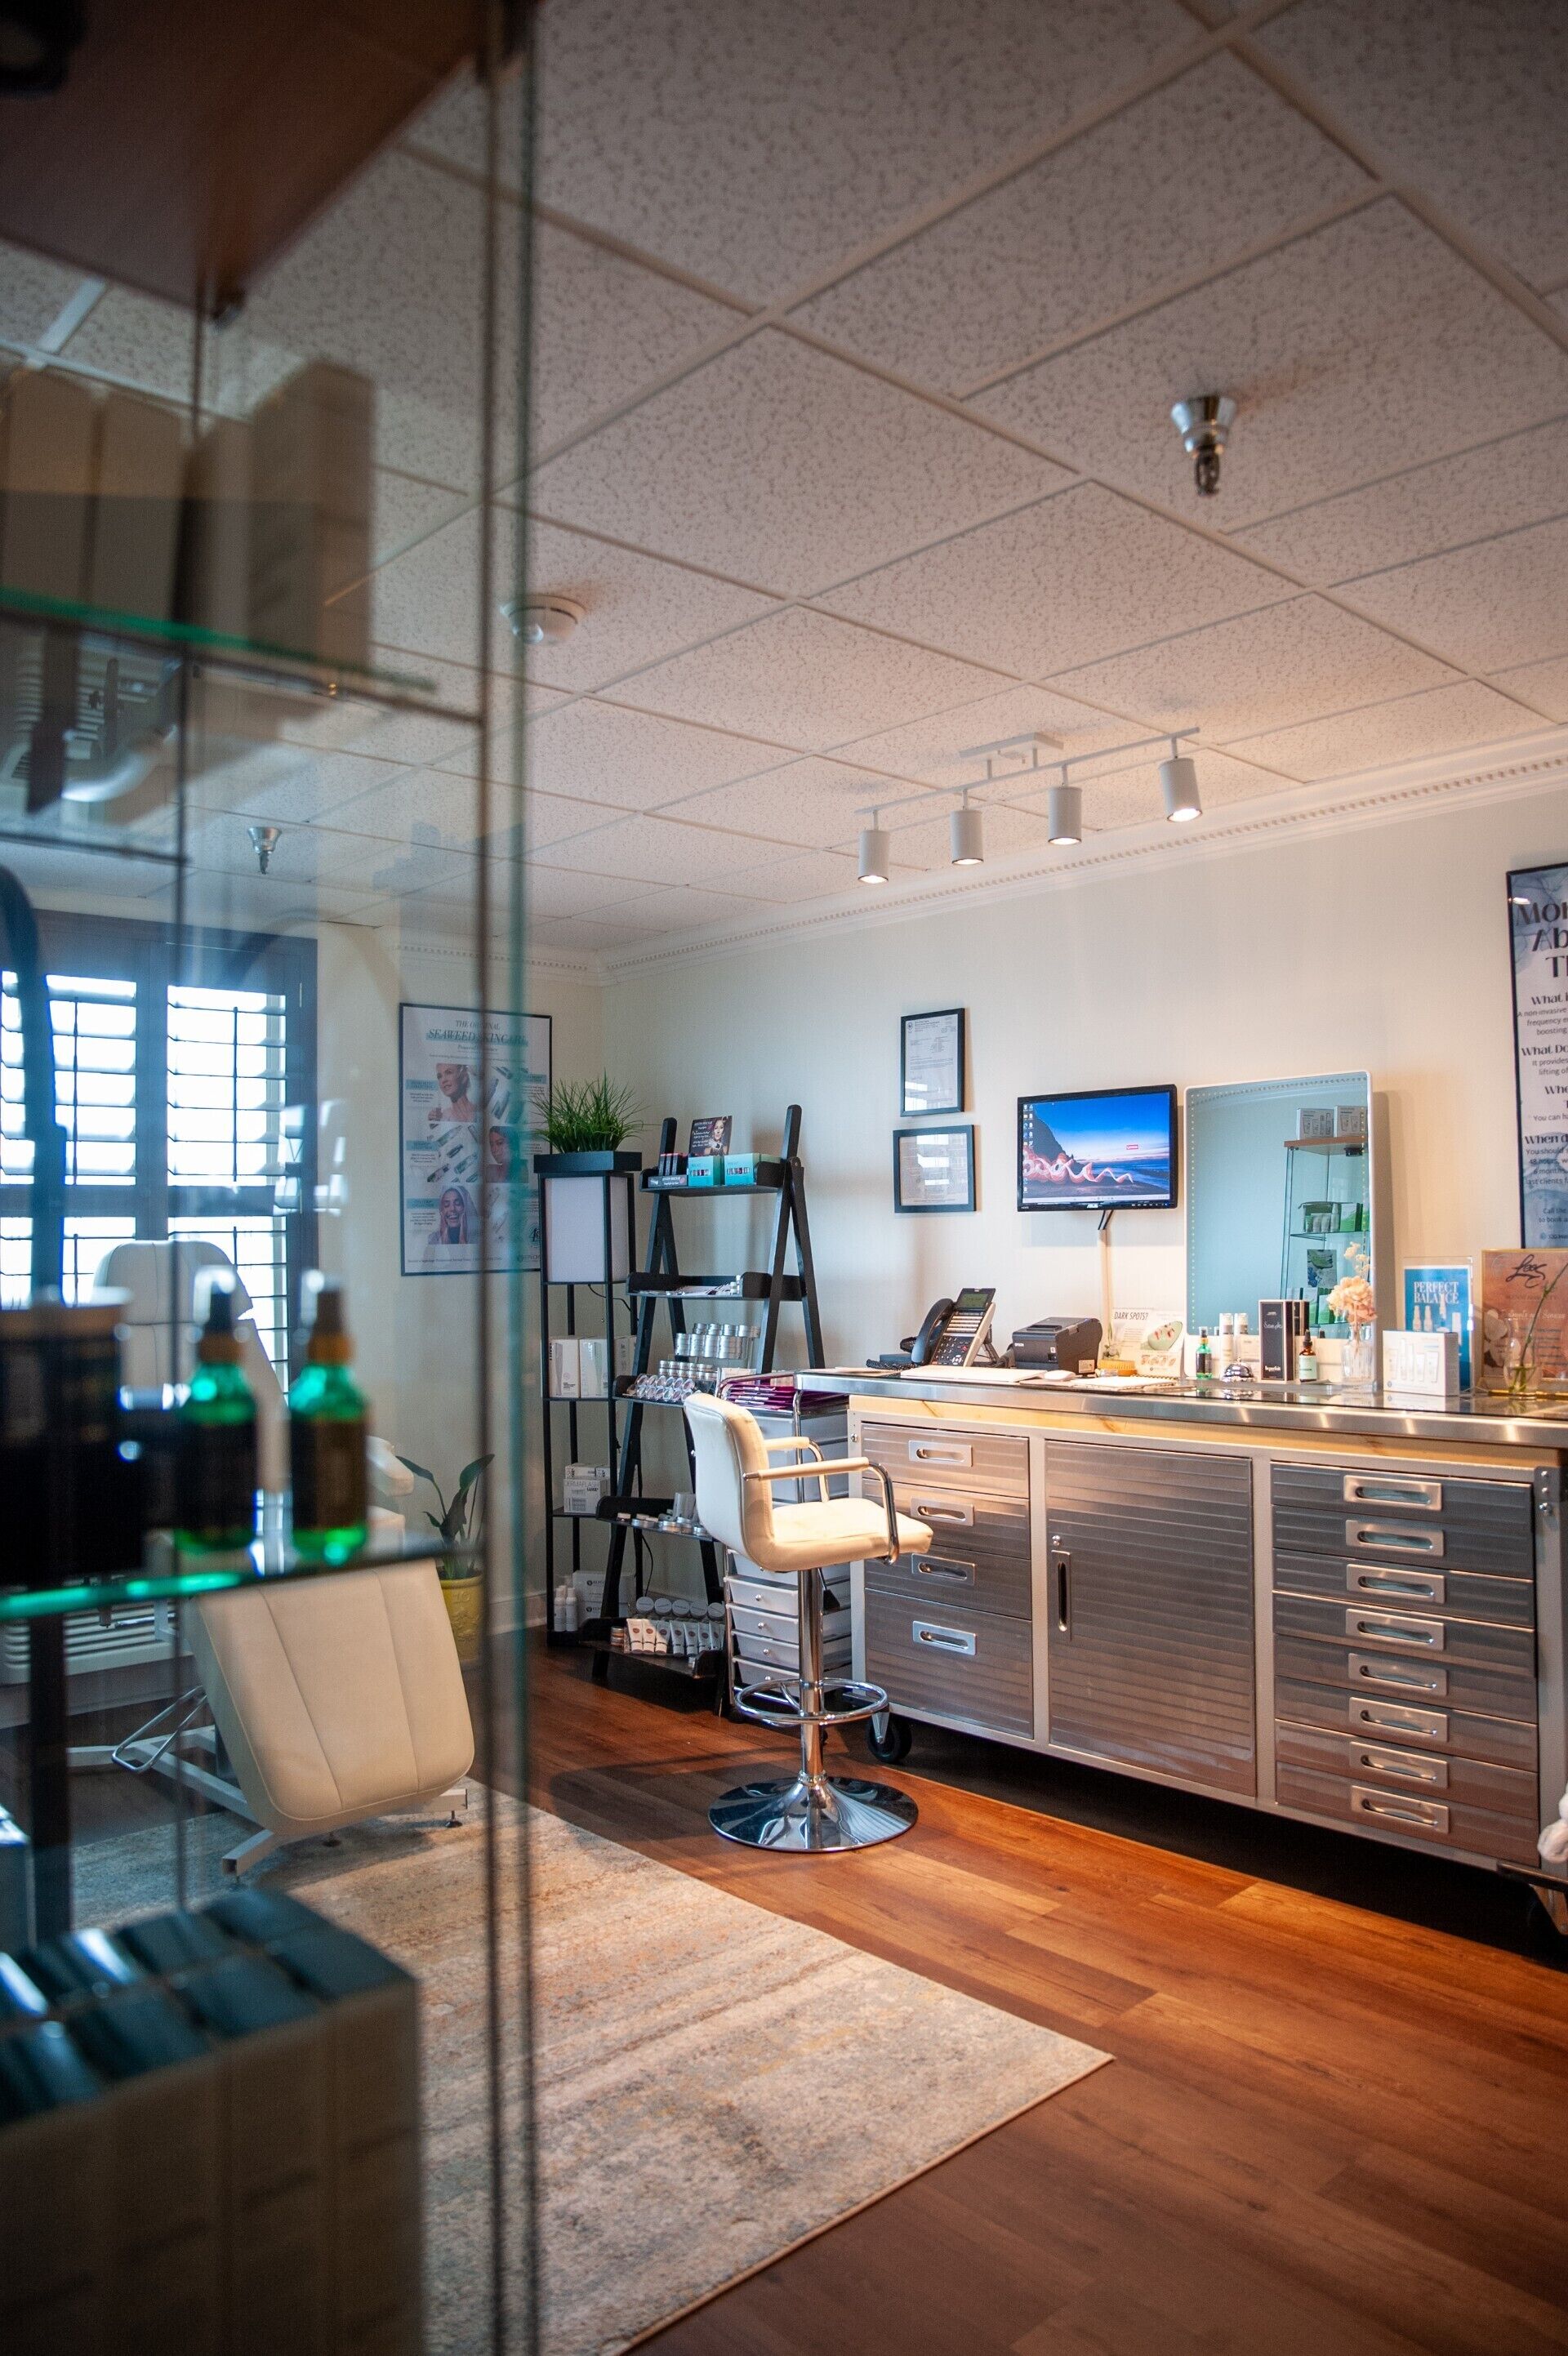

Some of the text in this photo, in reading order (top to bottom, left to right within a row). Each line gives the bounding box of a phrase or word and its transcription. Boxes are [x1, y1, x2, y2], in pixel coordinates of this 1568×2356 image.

[1545, 955, 1568, 978] T
[1530, 993, 1562, 1005] What
[1524, 1007, 1567, 1017] non-invasive
[455, 1019, 469, 1028] THE
[1526, 1018, 1561, 1027] frequency
[428, 1029, 476, 1041] SEAWEED
[1536, 1027, 1567, 1036] boosting
[1521, 1045, 1552, 1056] What
[1524, 1134, 1559, 1144] When
[1414, 1280, 1459, 1293] PERFECT
[1114, 1312, 1149, 1321] DARK SPOTS?
